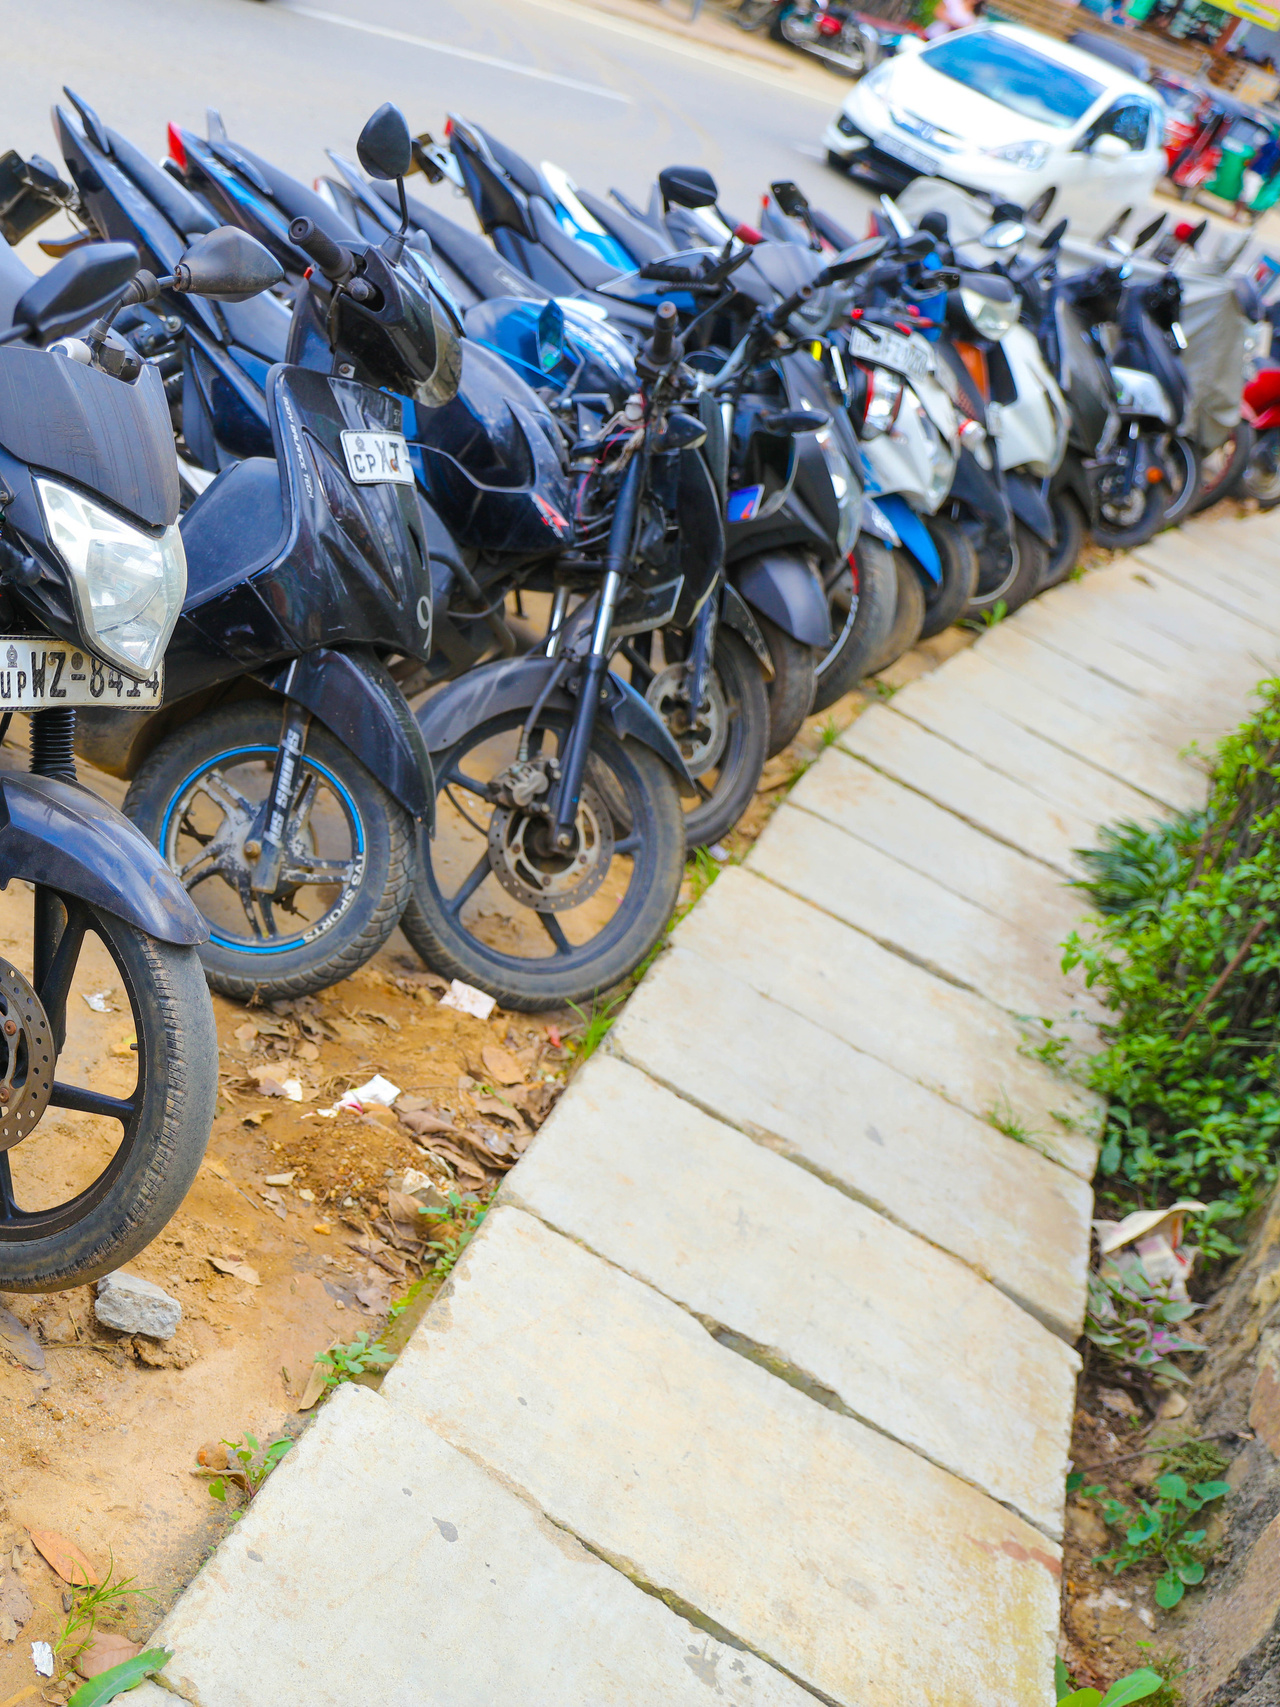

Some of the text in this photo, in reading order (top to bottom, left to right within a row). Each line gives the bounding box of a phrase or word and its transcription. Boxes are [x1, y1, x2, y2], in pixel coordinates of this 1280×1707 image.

[283, 396, 315, 499] BODY BALANCE TECH
[353, 453, 376, 474] CP
[0, 670, 27, 698] UP
[302, 888, 356, 941] SPORTS
